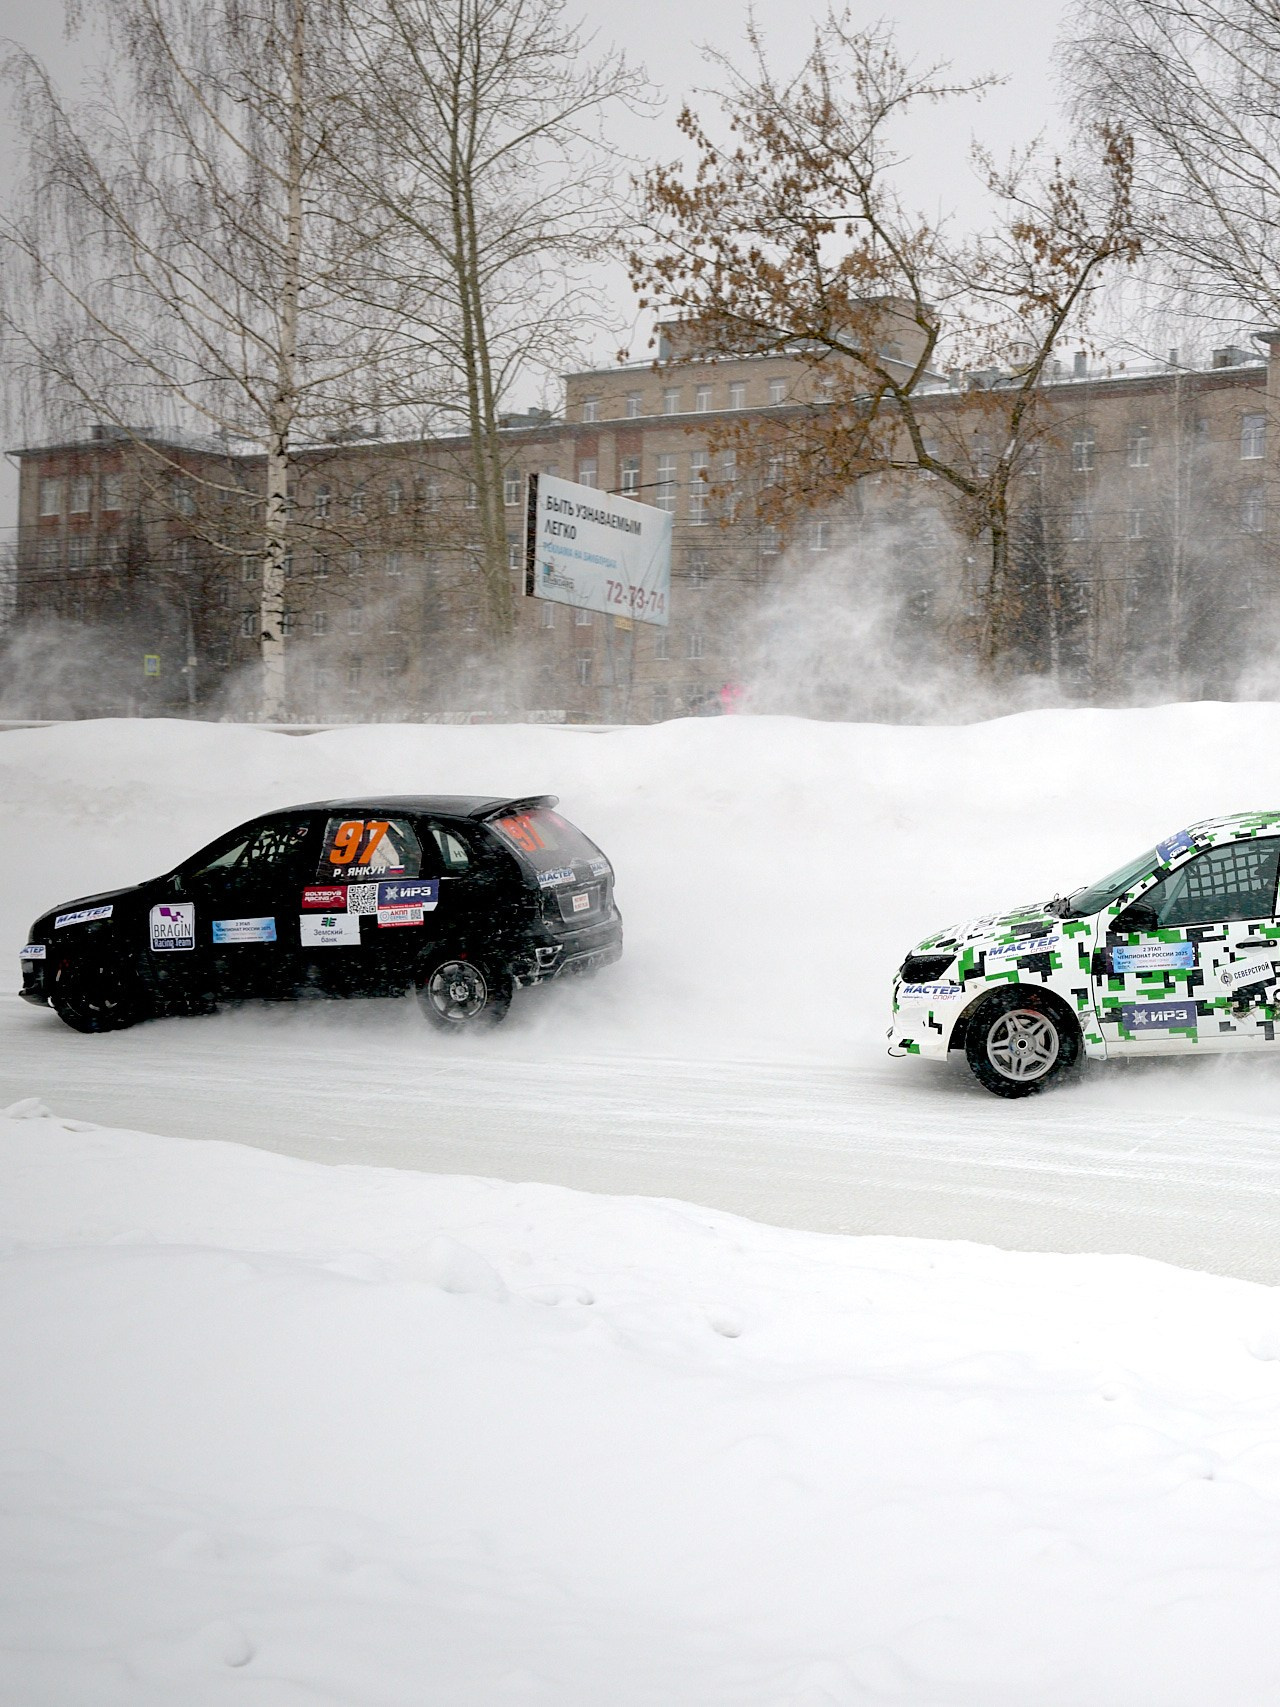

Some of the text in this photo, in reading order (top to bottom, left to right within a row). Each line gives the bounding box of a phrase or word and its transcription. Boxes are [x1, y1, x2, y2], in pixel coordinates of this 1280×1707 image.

[546, 495, 642, 536] БЫТЬ УЗНАВАЕМЫМ
[544, 519, 577, 540] ЛЕГКО
[606, 580, 665, 614] 72-73-74
[502, 815, 545, 852] 97
[330, 820, 389, 864] 97
[333, 866, 386, 877] Р. ЯНКУН
[539, 869, 573, 883] МАСТЕР
[400, 886, 431, 897] ИРЗ
[57, 906, 112, 924] МАСТЕР
[314, 928, 343, 936] Земский
[154, 938, 192, 948] Racing Team
[320, 935, 337, 943] банк
[20, 946, 44, 954] АСТЕР
[989, 936, 1060, 956] МАСТЕР
[1031, 945, 1056, 953] СПОРТ
[1234, 962, 1270, 980] СЕВЕРСТРОЙ
[903, 985, 960, 995] МАСТЕР
[1150, 1009, 1188, 1022] ИРЗ
